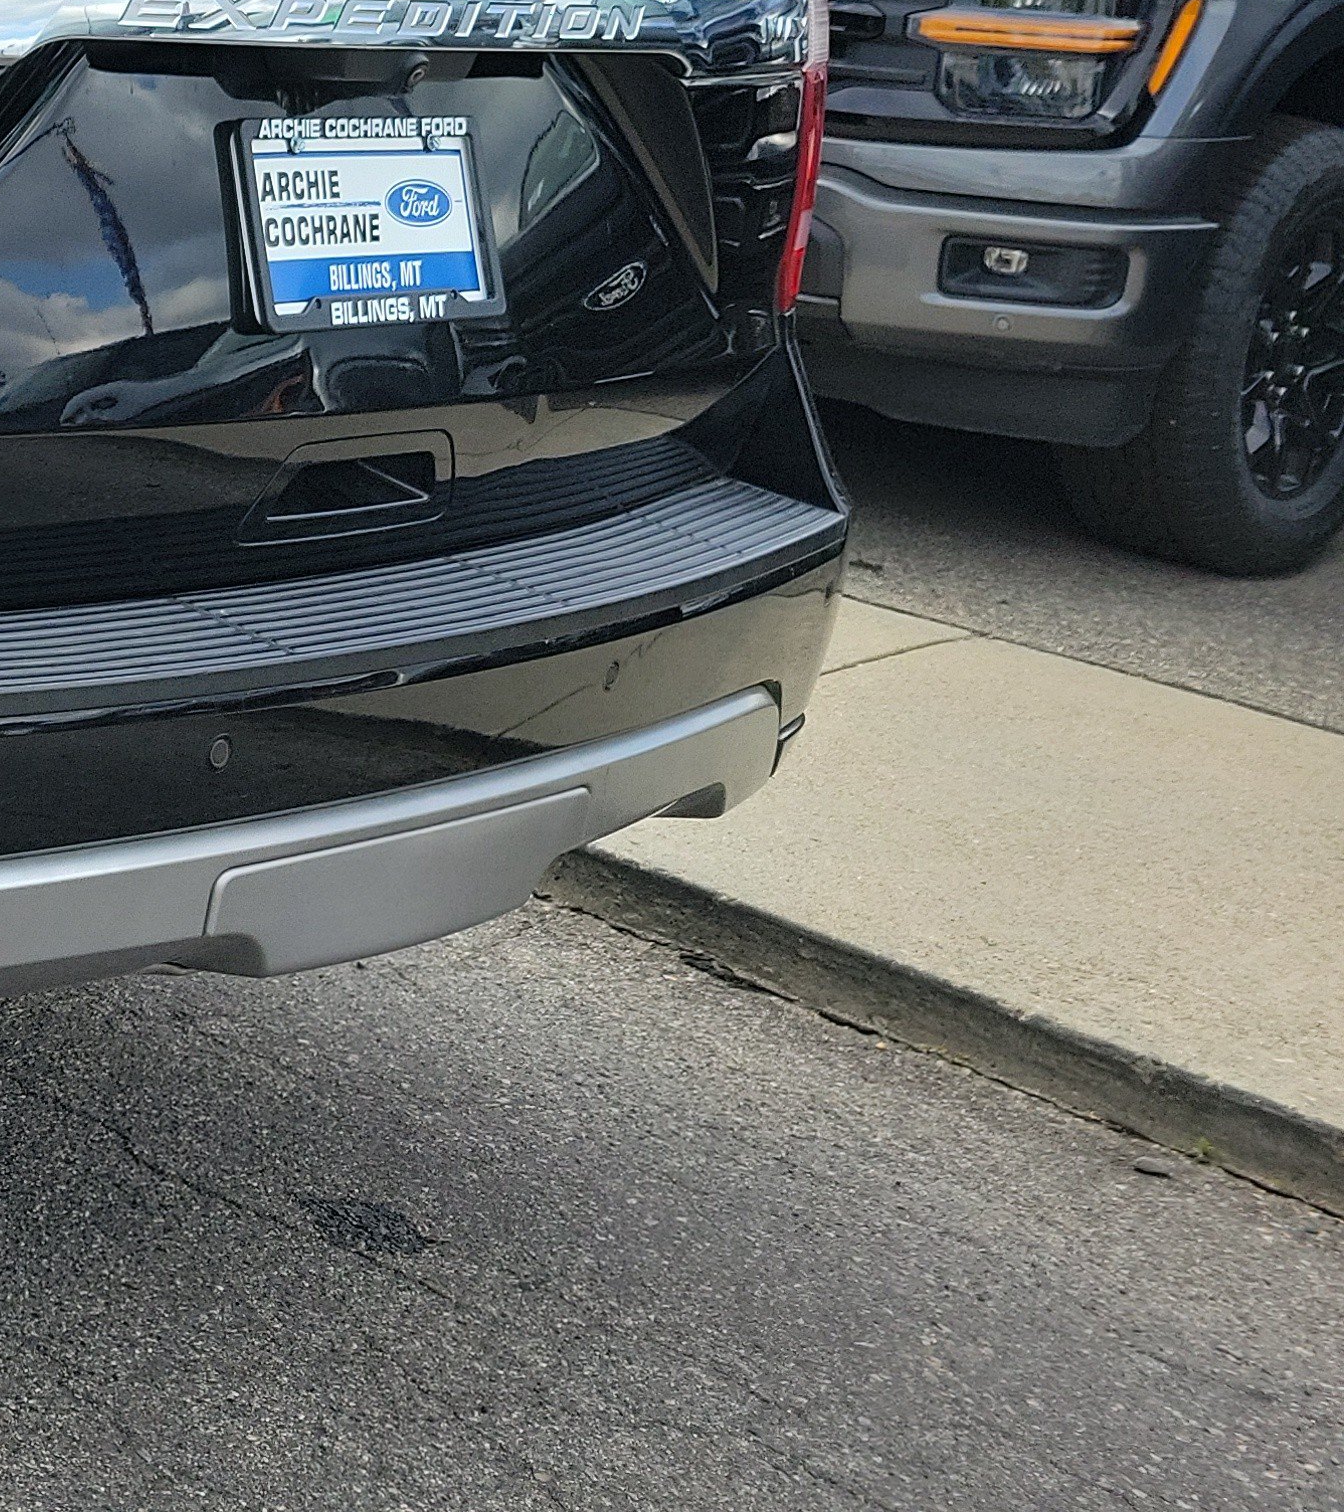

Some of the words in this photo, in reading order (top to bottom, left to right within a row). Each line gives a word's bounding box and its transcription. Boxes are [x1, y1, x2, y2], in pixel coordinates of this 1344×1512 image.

[259, 117, 321, 138] ARCHIE
[324, 117, 417, 138] COCHRANE
[421, 117, 467, 137] FORD
[261, 170, 341, 202] ARCHIE
[400, 186, 440, 218] Ford
[264, 213, 381, 248] COCHRANE
[329, 262, 397, 292] BILLINGS,
[400, 260, 422, 287] MT
[330, 298, 416, 326] BILLINGS,
[419, 294, 448, 319] MT
